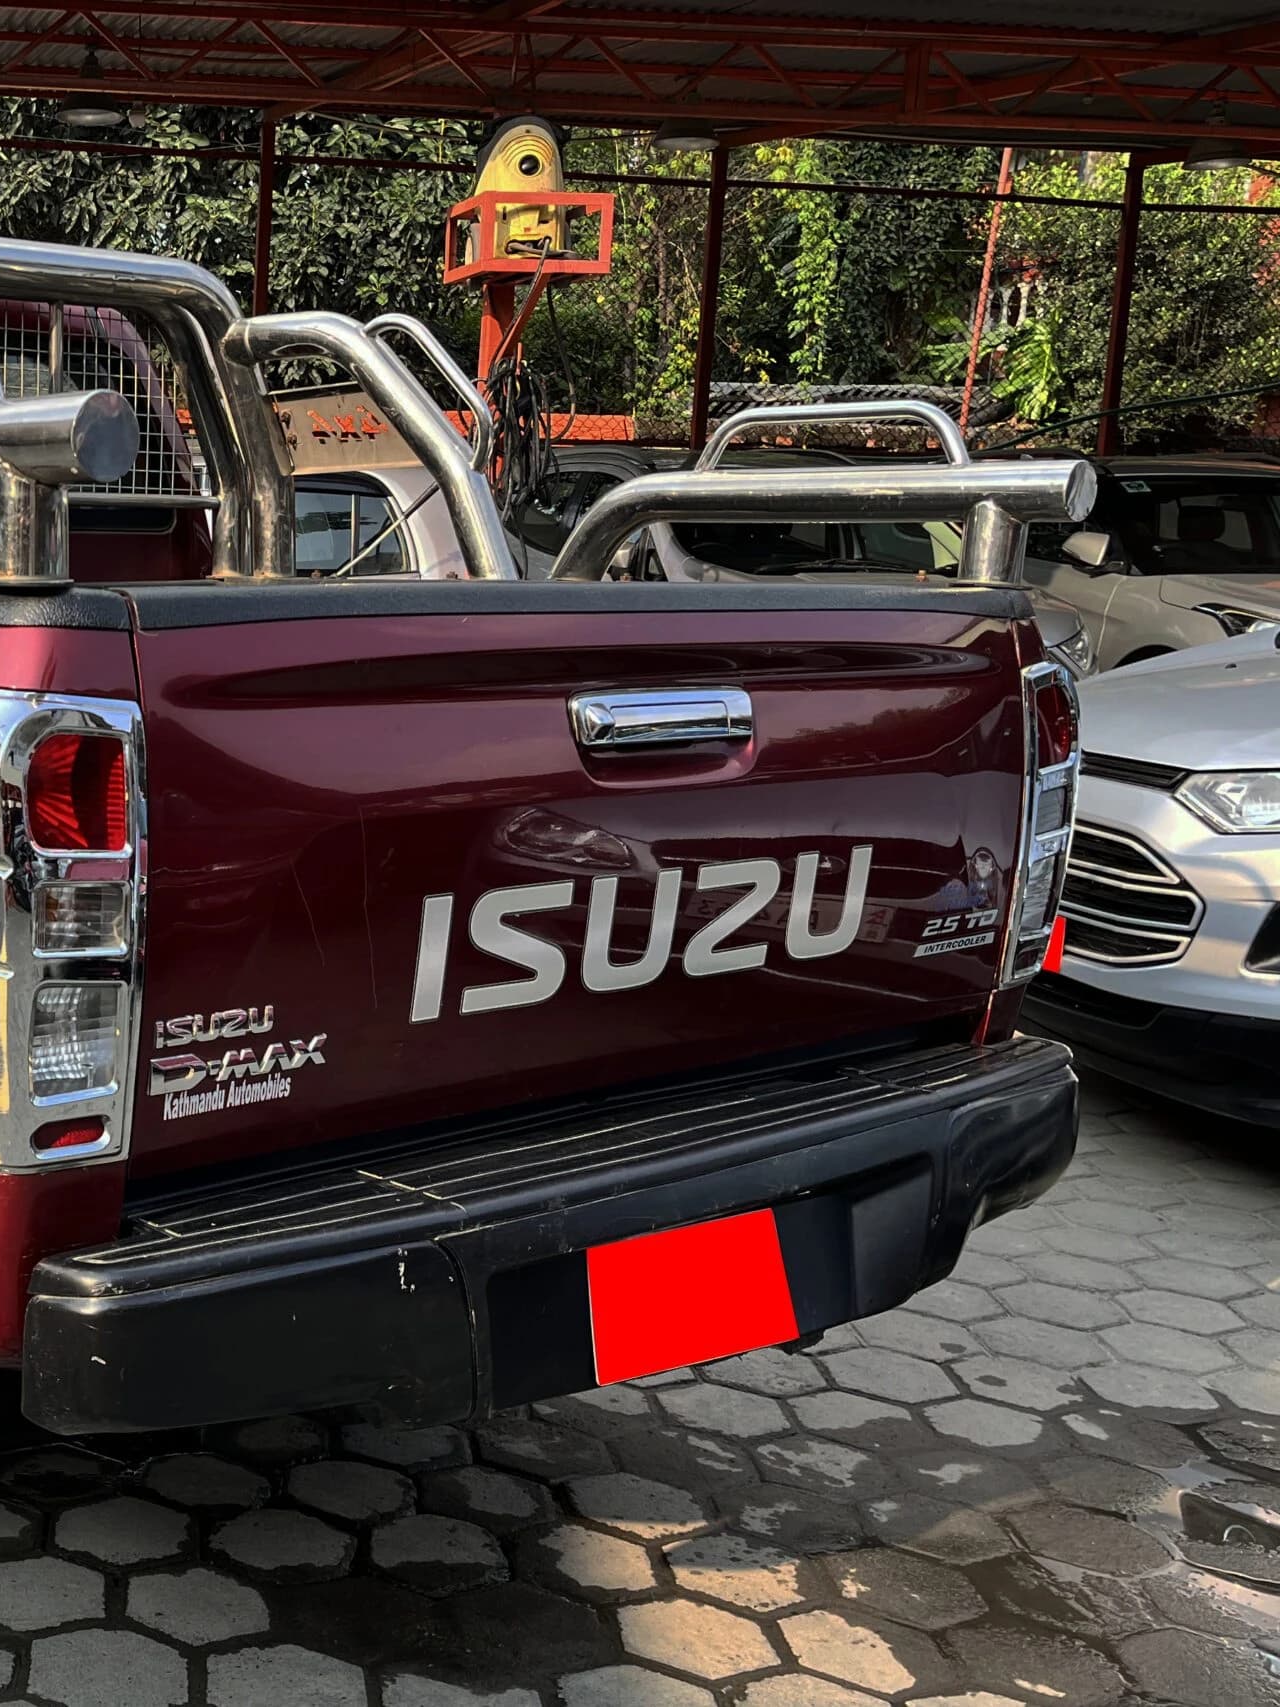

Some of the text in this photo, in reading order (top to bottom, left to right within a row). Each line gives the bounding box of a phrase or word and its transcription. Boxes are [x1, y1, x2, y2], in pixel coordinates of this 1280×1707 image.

[409, 843, 874, 1025] ISUZU
[923, 934, 987, 954] INTERCOOLER
[155, 1004, 274, 1049] ISUZU
[147, 1032, 328, 1096] D-MAX
[163, 1072, 292, 1121] Kathmandu Automobiles
